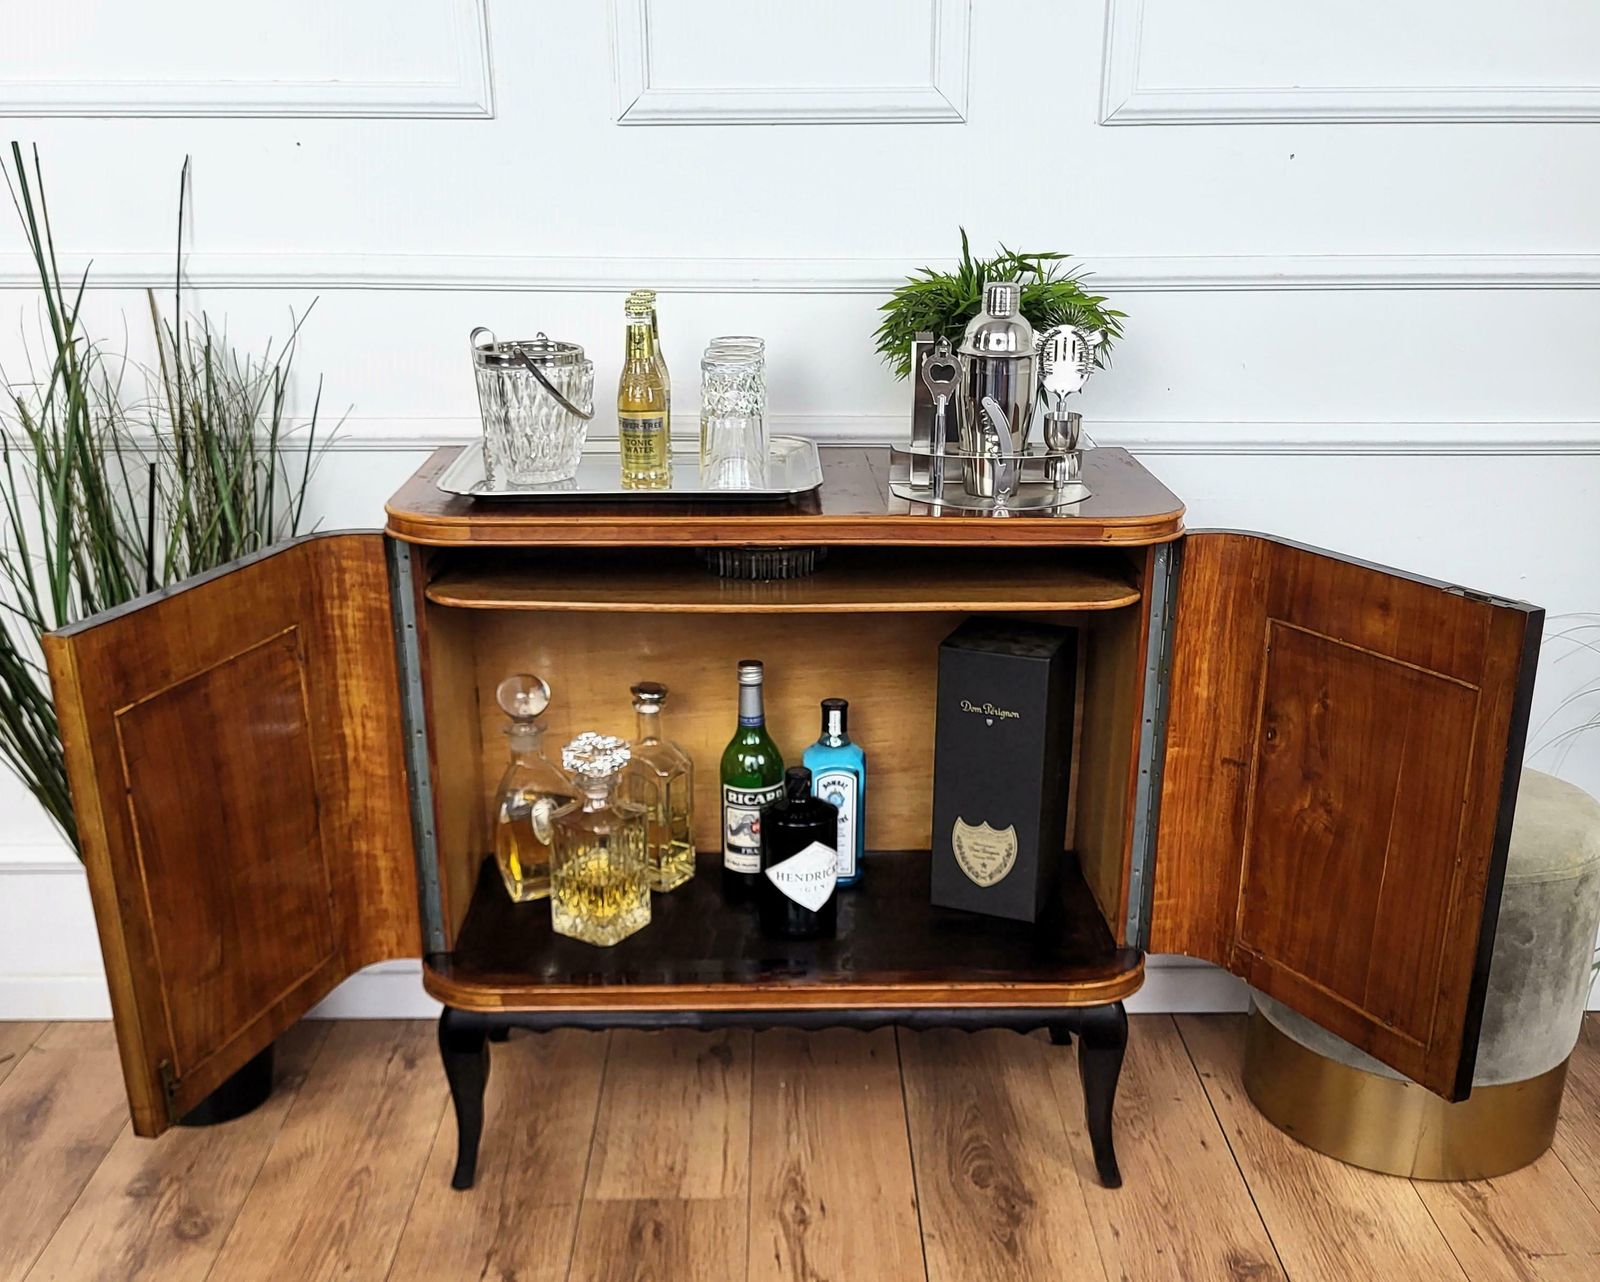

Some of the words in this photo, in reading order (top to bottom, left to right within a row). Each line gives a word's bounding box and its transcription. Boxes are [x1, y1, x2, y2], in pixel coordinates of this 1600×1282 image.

[626, 439, 654, 447] TONIC
[625, 446, 655, 454] WATER
[960, 700, 982, 714] Dom
